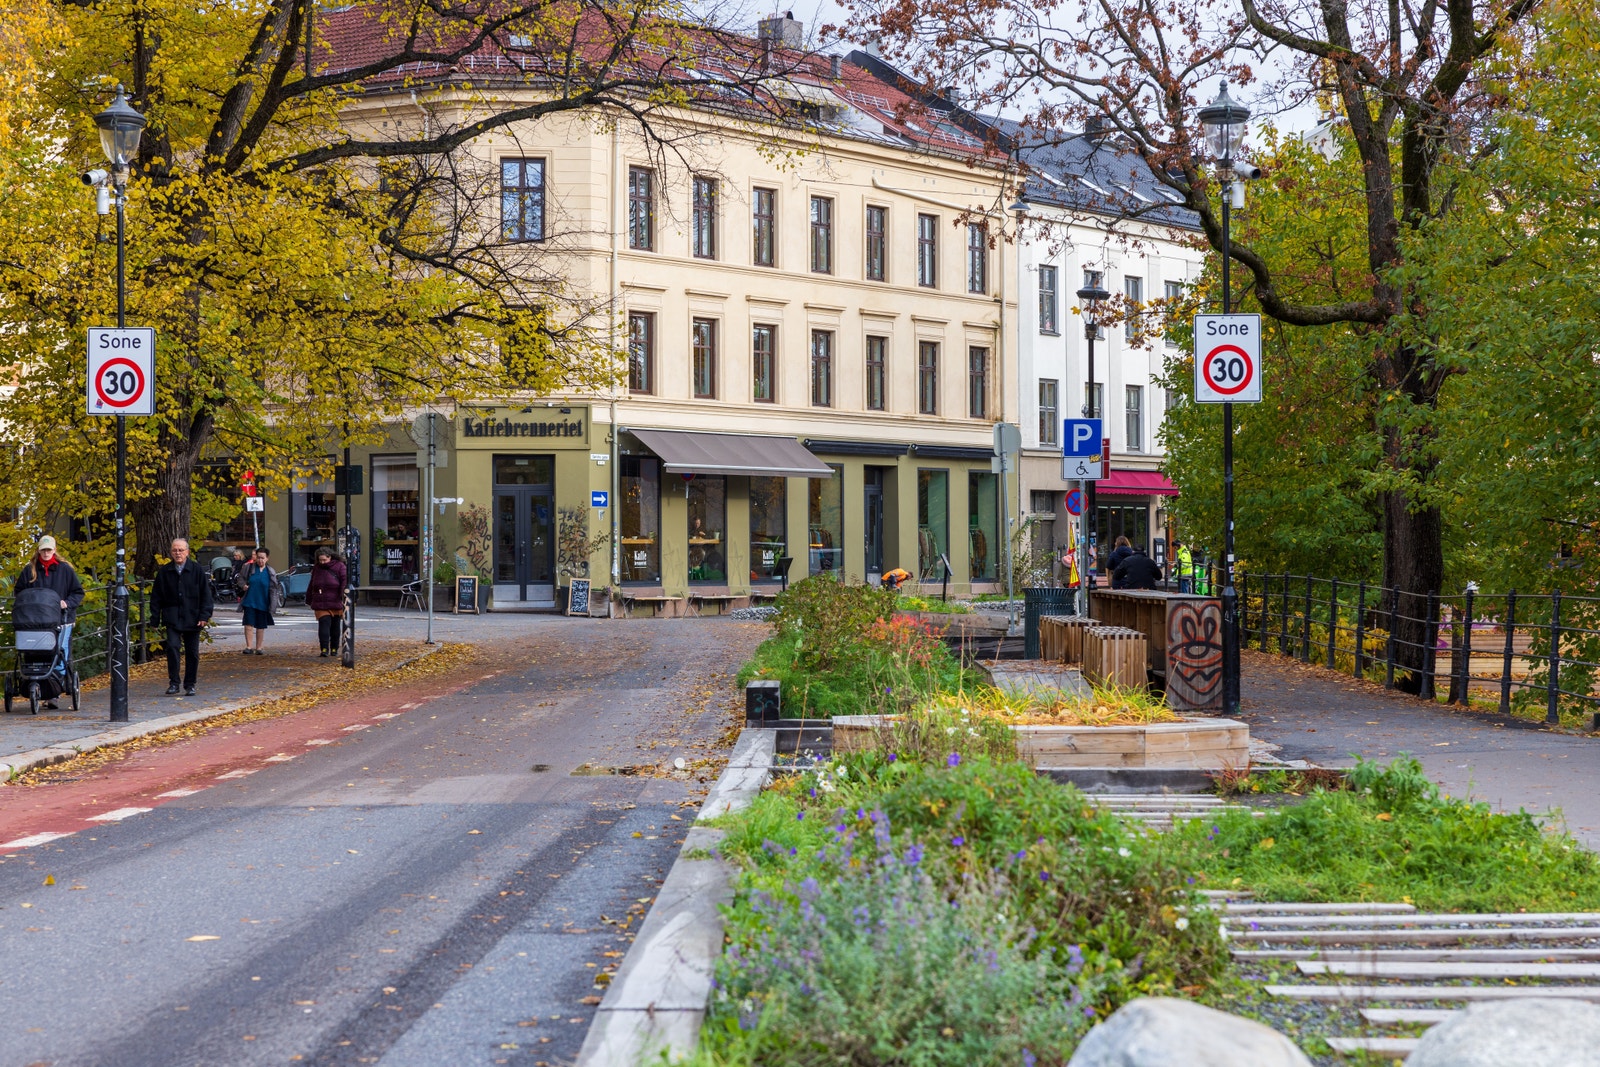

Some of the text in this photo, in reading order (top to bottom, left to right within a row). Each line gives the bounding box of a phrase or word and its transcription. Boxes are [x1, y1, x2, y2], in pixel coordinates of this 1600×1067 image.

[1206, 320, 1249, 336] Sone
[99, 333, 142, 349] Sone
[1212, 357, 1244, 382] 30
[104, 370, 136, 395] 30
[464, 417, 583, 437] Kaffebrenneriet
[1073, 423, 1093, 453] P
